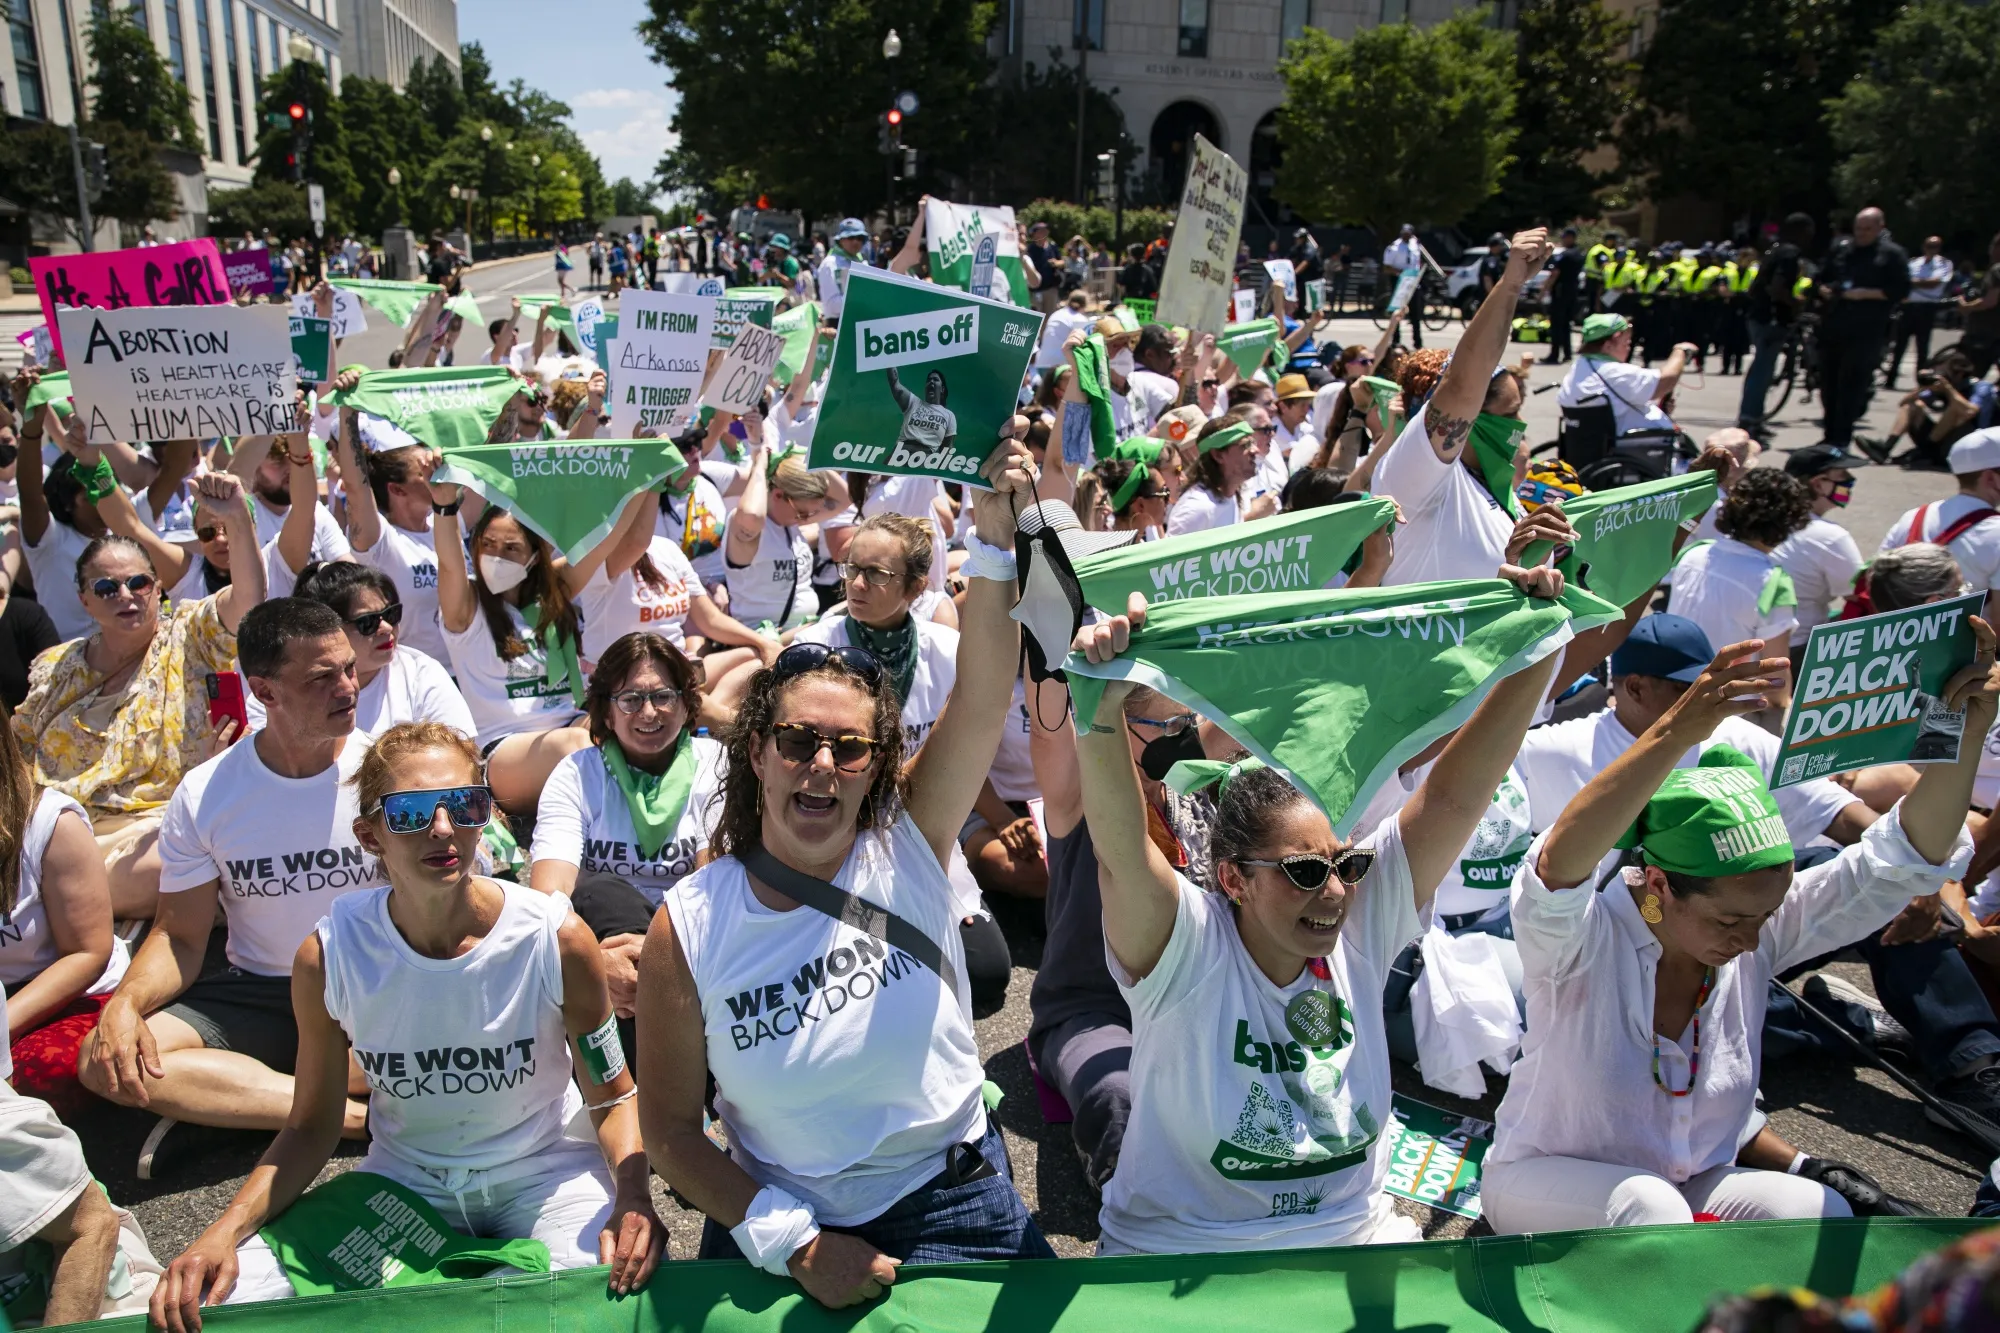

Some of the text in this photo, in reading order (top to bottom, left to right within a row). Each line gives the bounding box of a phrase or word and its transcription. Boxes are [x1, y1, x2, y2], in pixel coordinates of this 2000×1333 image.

[144, 255, 227, 307] GIRL
[731, 302, 766, 311] WON'T
[637, 309, 698, 334] I'M FROM
[713, 323, 743, 335] DOW
[863, 327, 930, 358] bans
[937, 313, 973, 346] off
[1004, 322, 1019, 335] CPD
[1001, 333, 1027, 347] ACTION
[621, 342, 701, 373] Arkansas
[162, 362, 290, 383] HEALTHCARE
[136, 383, 256, 403] HEALTHCARE
[392, 385, 421, 403] WE
[401, 393, 490, 418] BACK DOWN
[626, 385, 692, 406] A TRIGGER
[89, 405, 117, 441] A
[130, 402, 241, 441] HUMAN
[640, 408, 676, 428] STATE
[510, 446, 634, 464] WE WON'T
[832, 441, 981, 476] our bodies
[512, 459, 630, 480] BACK DOWN
[1594, 501, 1682, 543] BACK DOWN
[1150, 535, 1312, 590] WE WON'T
[1228, 562, 1310, 595] DOWN
[640, 600, 687, 623] BODIE
[1817, 608, 1963, 662] WE WON'T
[512, 685, 535, 697] our
[1802, 650, 1918, 704] BACK
[1789, 688, 1921, 745] DOWN.
[1804, 761, 1832, 777] ACTION
[1808, 754, 1824, 766] CPD
[225, 845, 364, 881] WE WON
[586, 836, 697, 863] WE WON
[232, 864, 375, 898] BACK DOW
[585, 858, 646, 876] BACK
[1468, 867, 1498, 881] our
[725, 934, 886, 1021] WE WON
[731, 950, 922, 1051] BACK DOWN
[1308, 995, 1330, 1018] BANS
[1291, 1012, 1321, 1041] BODIES
[1299, 1004, 1332, 1036] OFF OUR
[591, 1027, 611, 1044] bans
[355, 1038, 535, 1078] WE WON'T
[442, 1060, 536, 1095] DOWN
[606, 1069, 617, 1079] our
[1384, 1134, 1433, 1194] BACK
[1416, 1136, 1469, 1202] DOWN.
[1272, 1192, 1298, 1209] CPD
[364, 1189, 447, 1258] ABORTION
[371, 1221, 408, 1256] IS A
[341, 1225, 406, 1282] HUMAN
